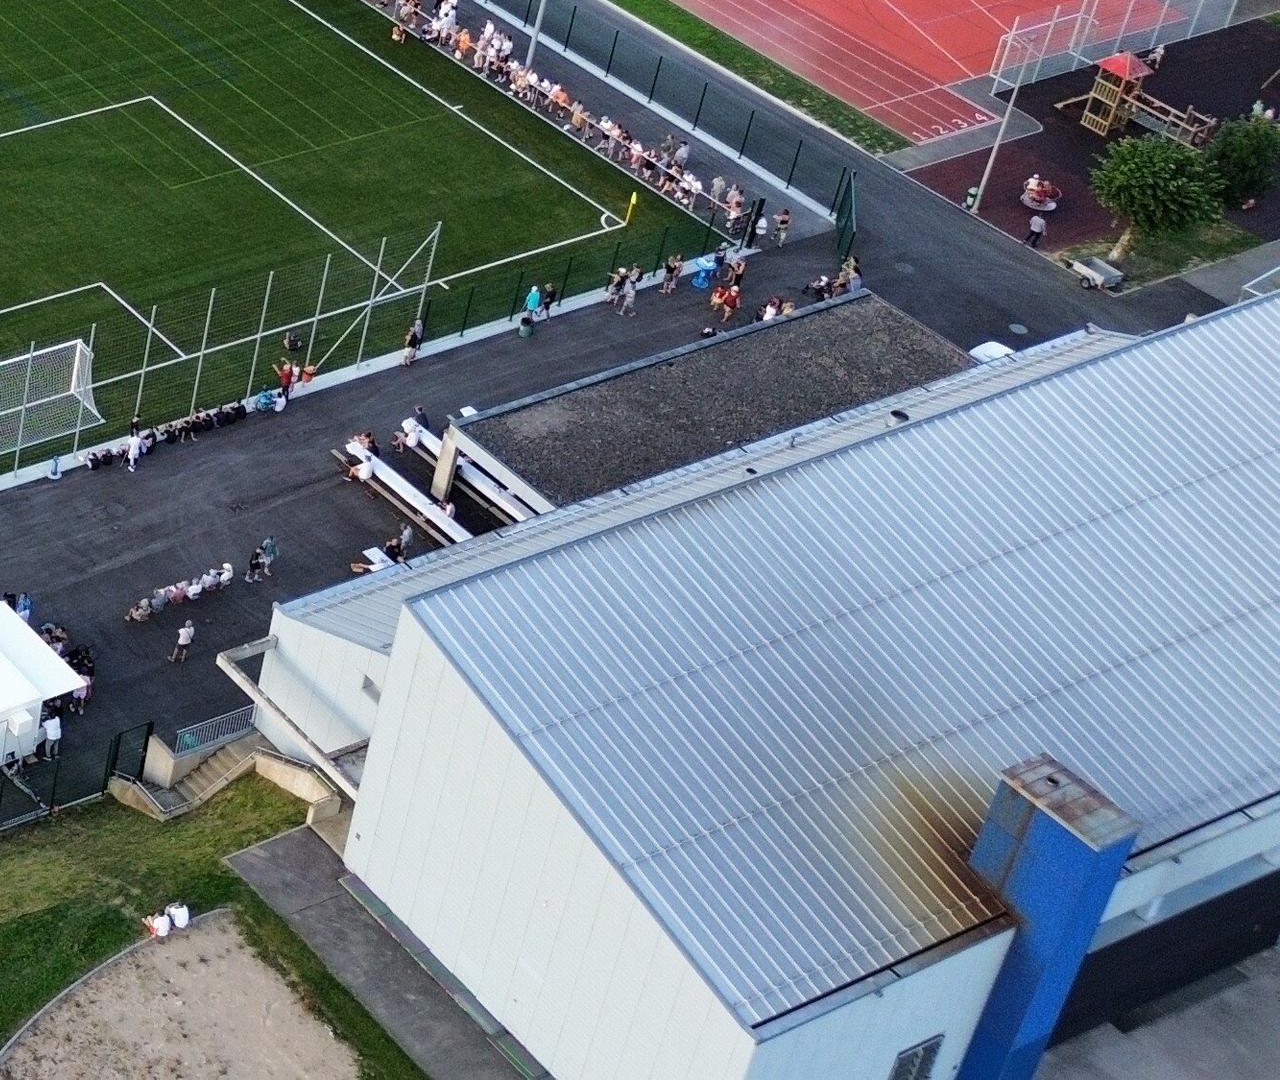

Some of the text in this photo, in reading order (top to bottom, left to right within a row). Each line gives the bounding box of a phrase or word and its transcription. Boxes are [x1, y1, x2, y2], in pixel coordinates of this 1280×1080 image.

[912, 112, 989, 140] 1 2 3 4
